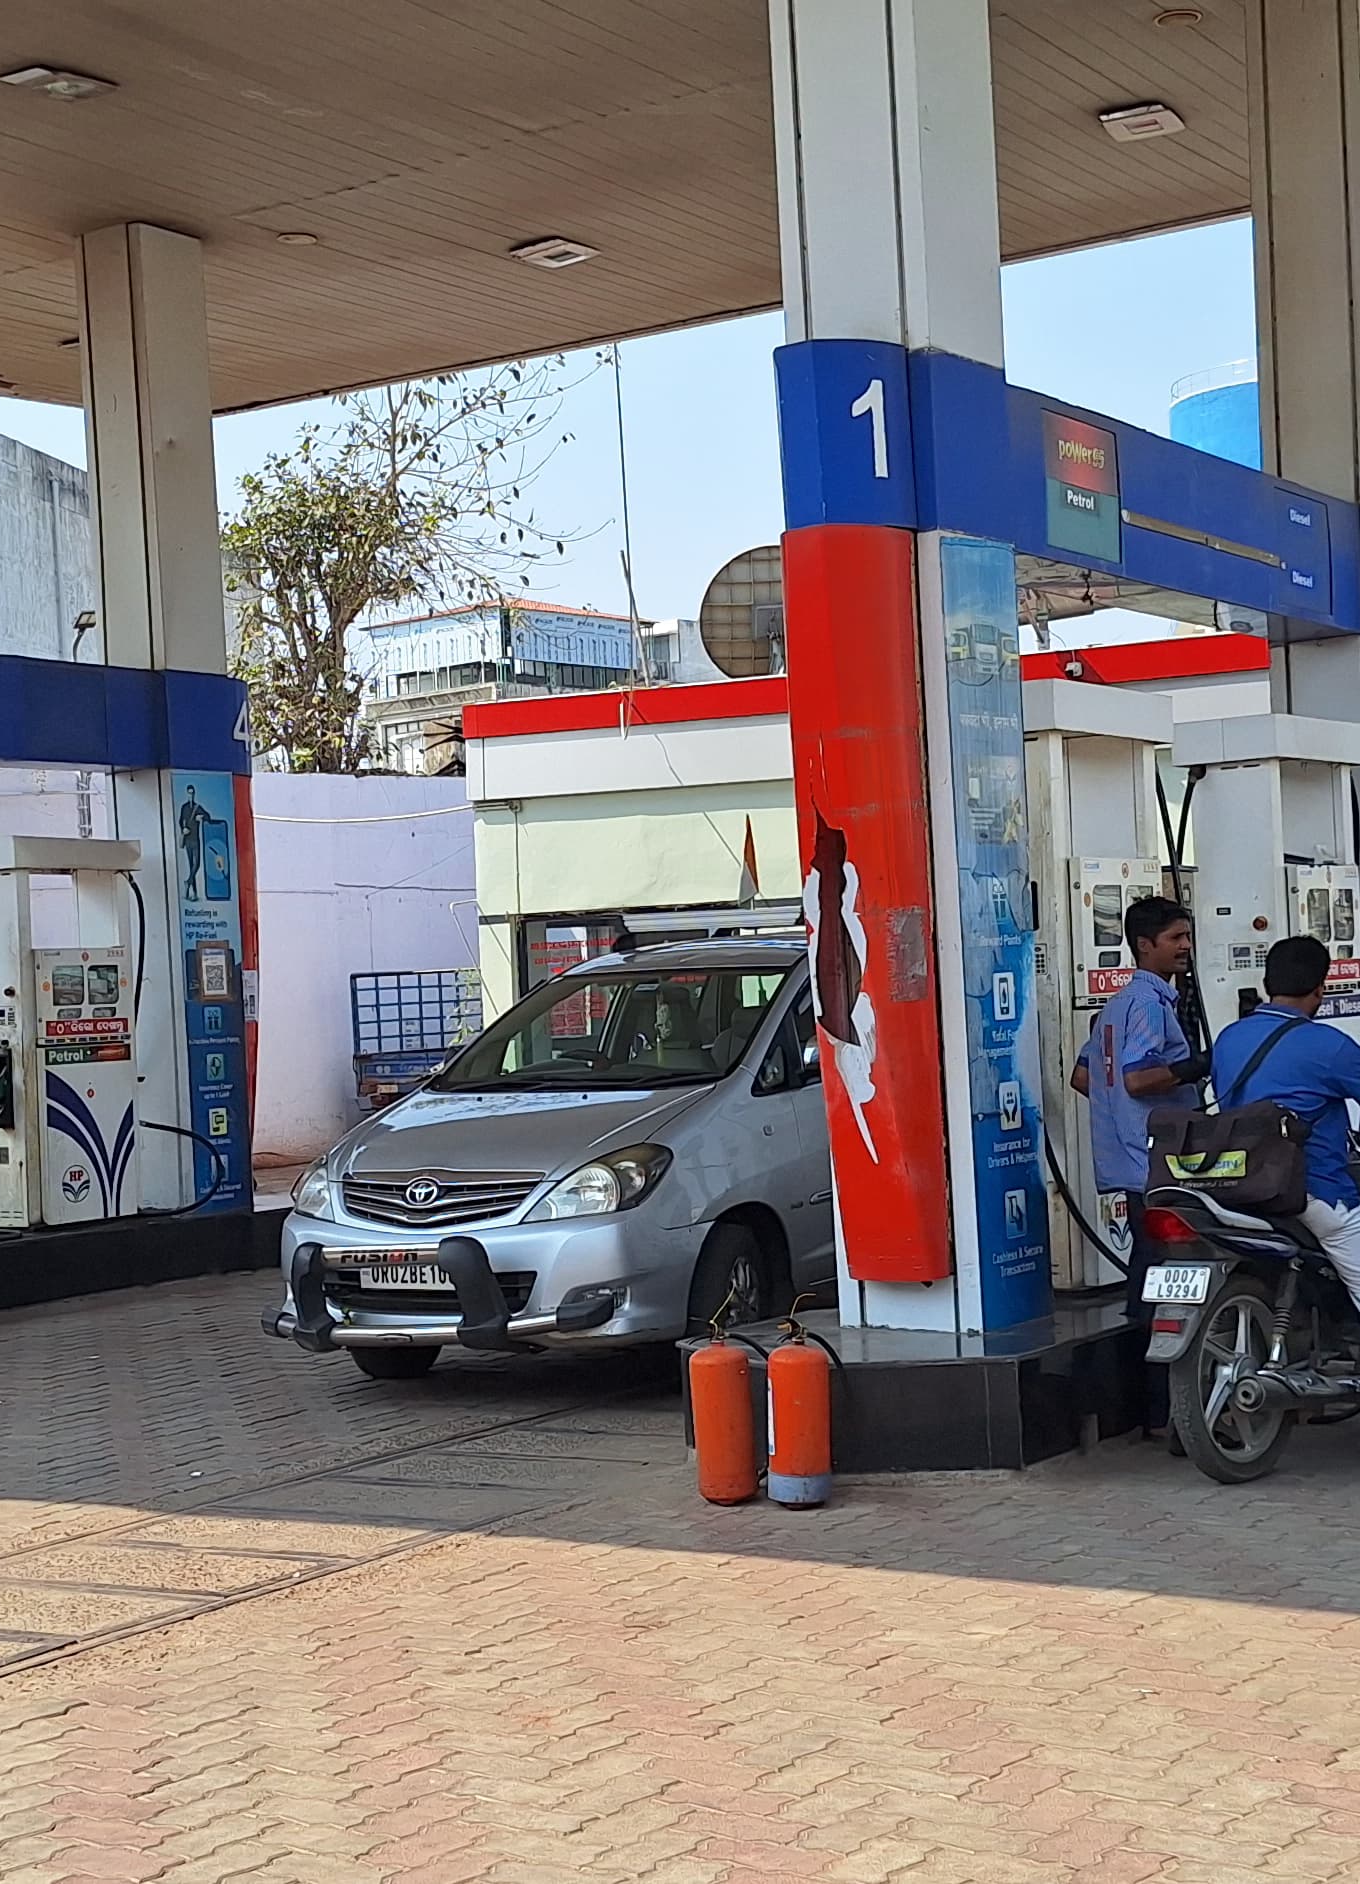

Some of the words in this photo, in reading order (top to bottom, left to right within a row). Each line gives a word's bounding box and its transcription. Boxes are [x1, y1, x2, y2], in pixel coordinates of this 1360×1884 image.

[851, 379, 888, 478] 1
[1067, 490, 1094, 510] Petrol
[1289, 508, 1311, 527] Diesel
[1292, 570, 1313, 588] Diesel
[233, 700, 249, 752] 4
[1003, 934, 1022, 946] Points
[48, 1050, 83, 1063] Petrol
[993, 1140, 1021, 1152] Insurance
[69, 1170, 84, 1182] HP
[341, 1249, 418, 1264] FUSION
[992, 1250, 1018, 1265] Cashless
[1157, 1283, 1199, 1298] L9294
